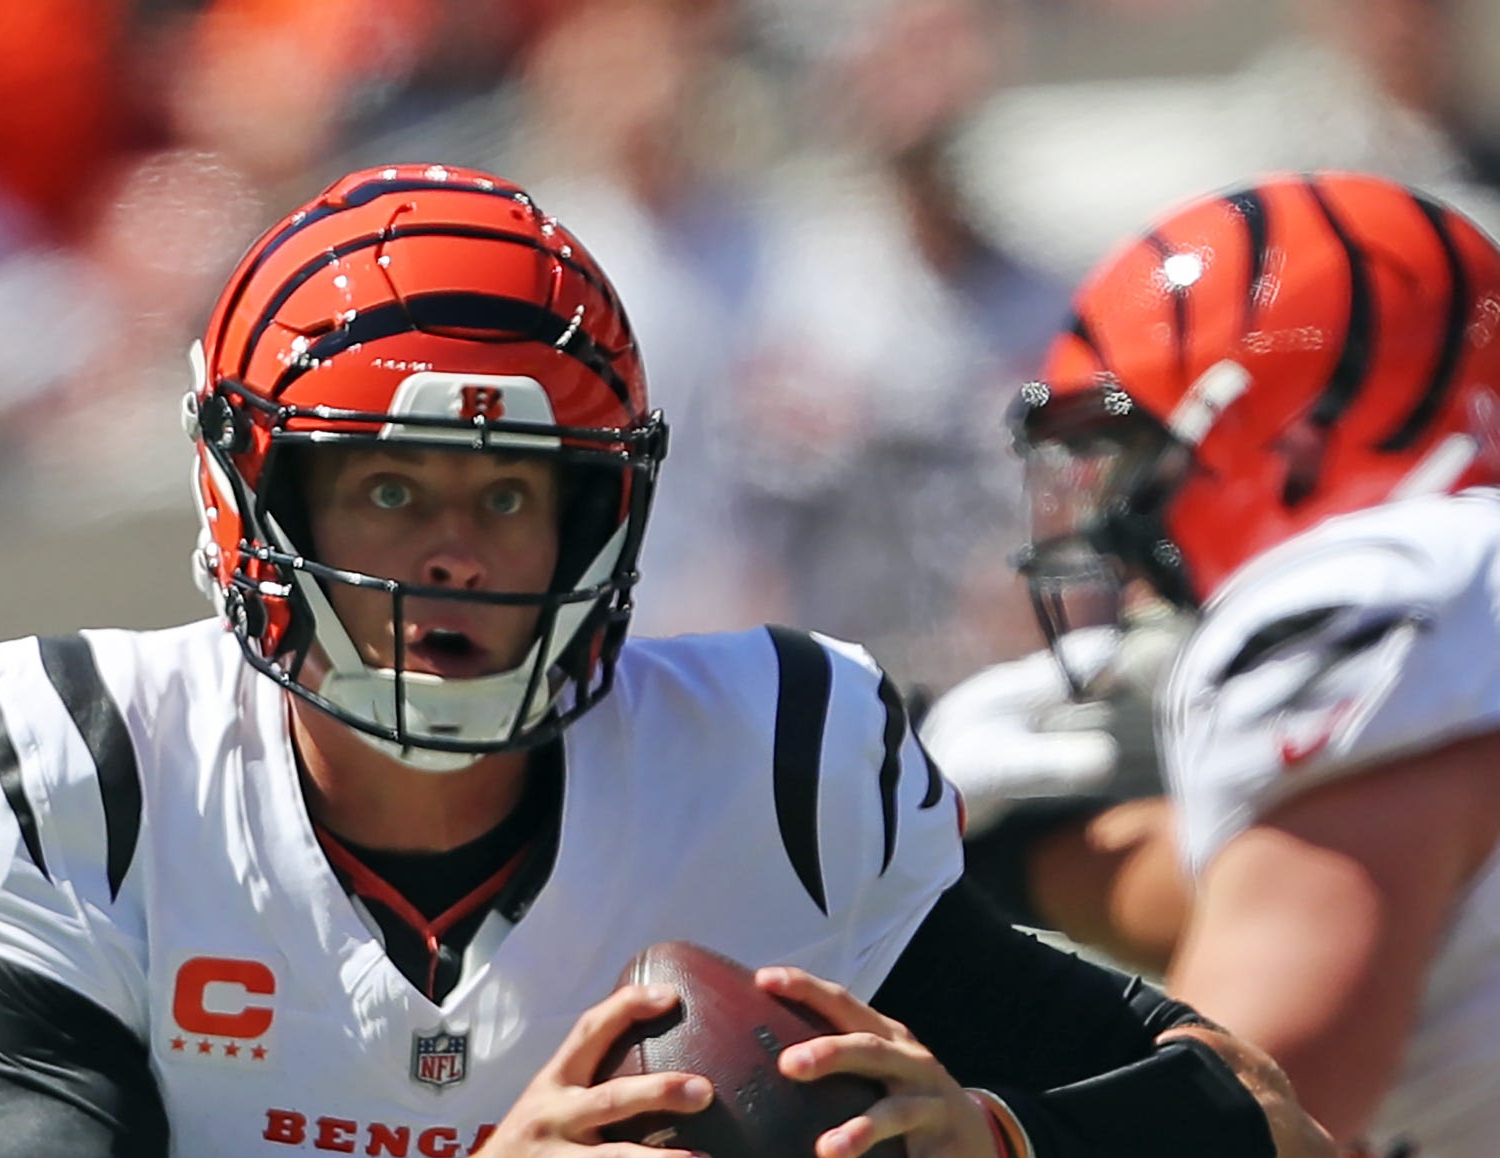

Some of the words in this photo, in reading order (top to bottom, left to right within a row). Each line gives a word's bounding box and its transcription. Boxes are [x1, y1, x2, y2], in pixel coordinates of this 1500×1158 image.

[172, 956, 276, 1037] C
[421, 1055, 462, 1081] NFL
[262, 1107, 498, 1158] BENG
